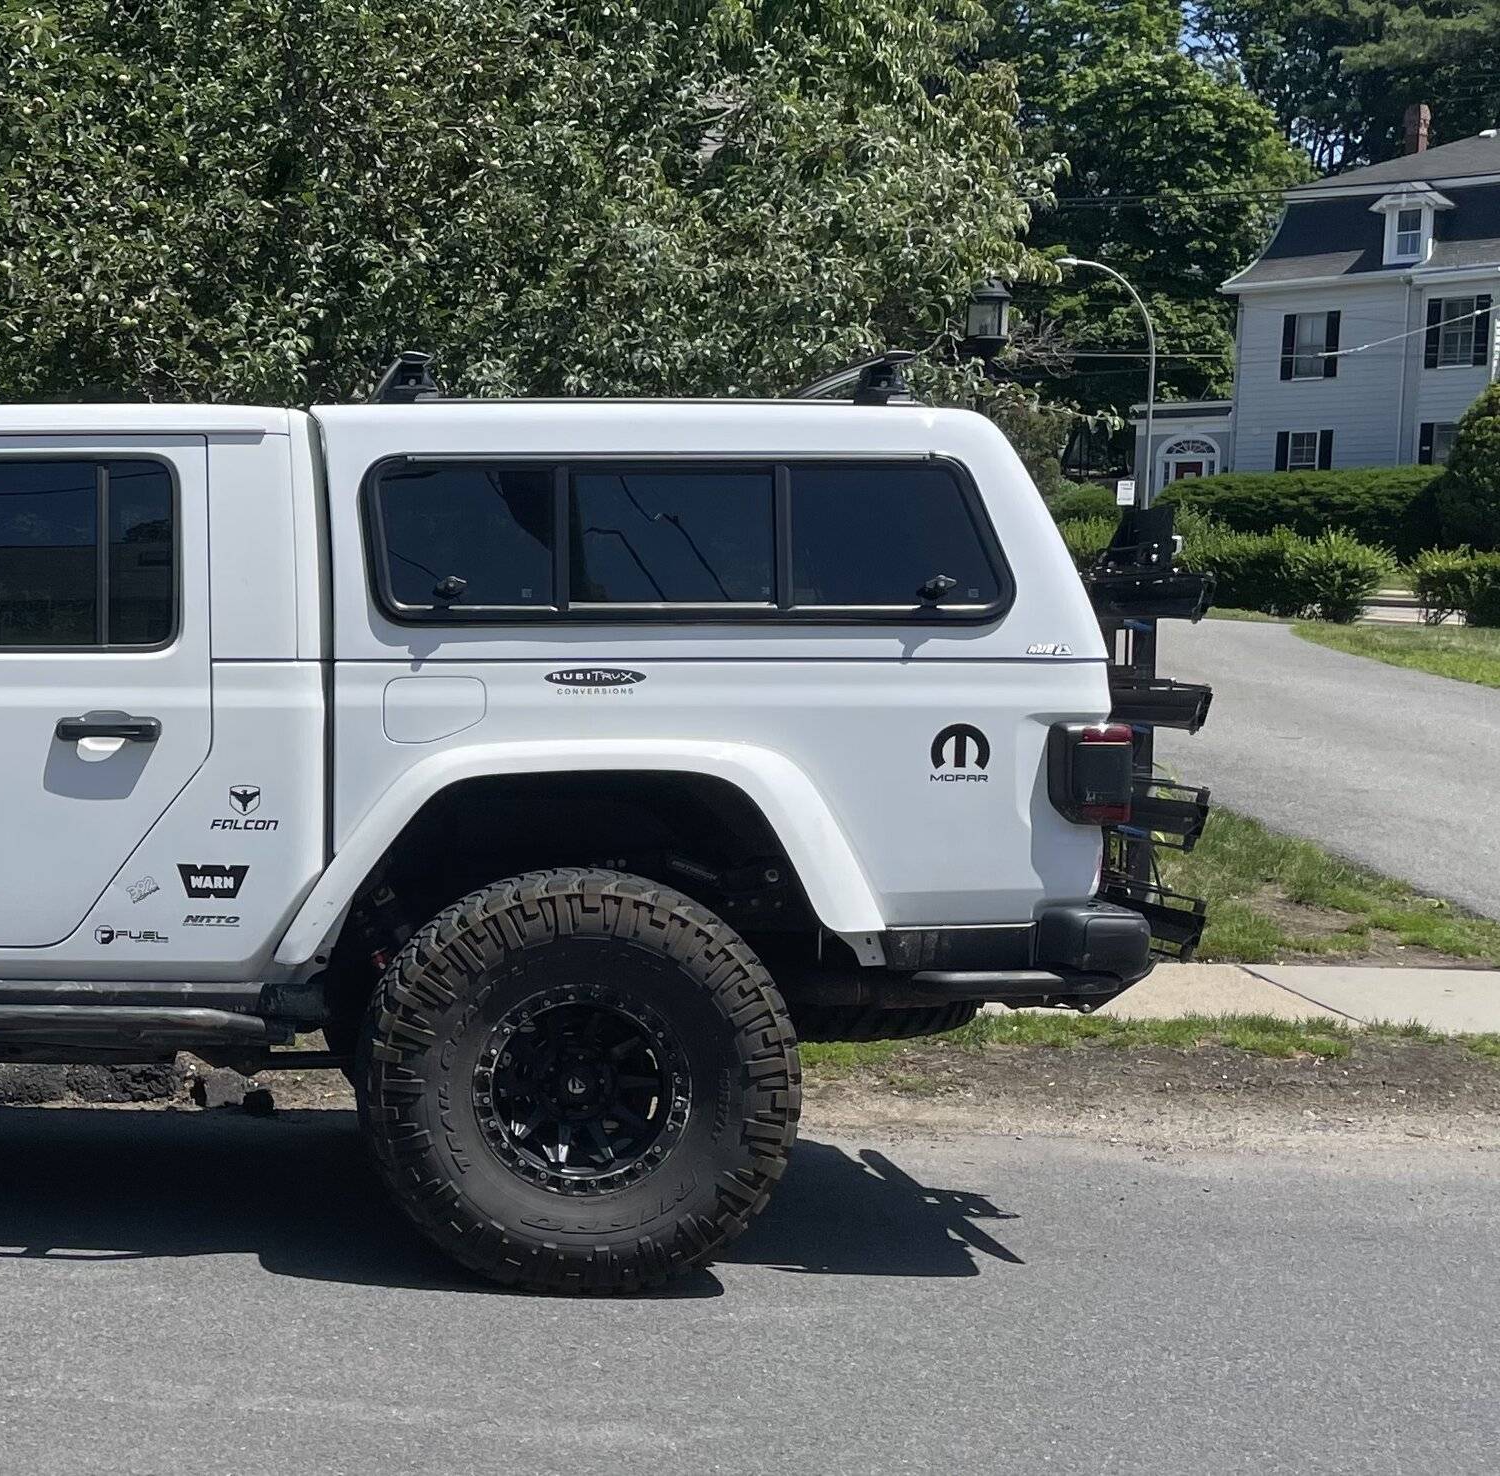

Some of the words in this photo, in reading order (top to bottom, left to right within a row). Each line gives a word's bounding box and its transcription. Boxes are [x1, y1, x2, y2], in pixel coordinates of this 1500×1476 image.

[557, 688, 635, 696] CONVERSIONS
[929, 773, 989, 783] MOPAR
[209, 818, 279, 831] FALCON
[189, 874, 235, 890] WARN
[184, 914, 240, 924] NITTO
[115, 929, 169, 940] FUEL
